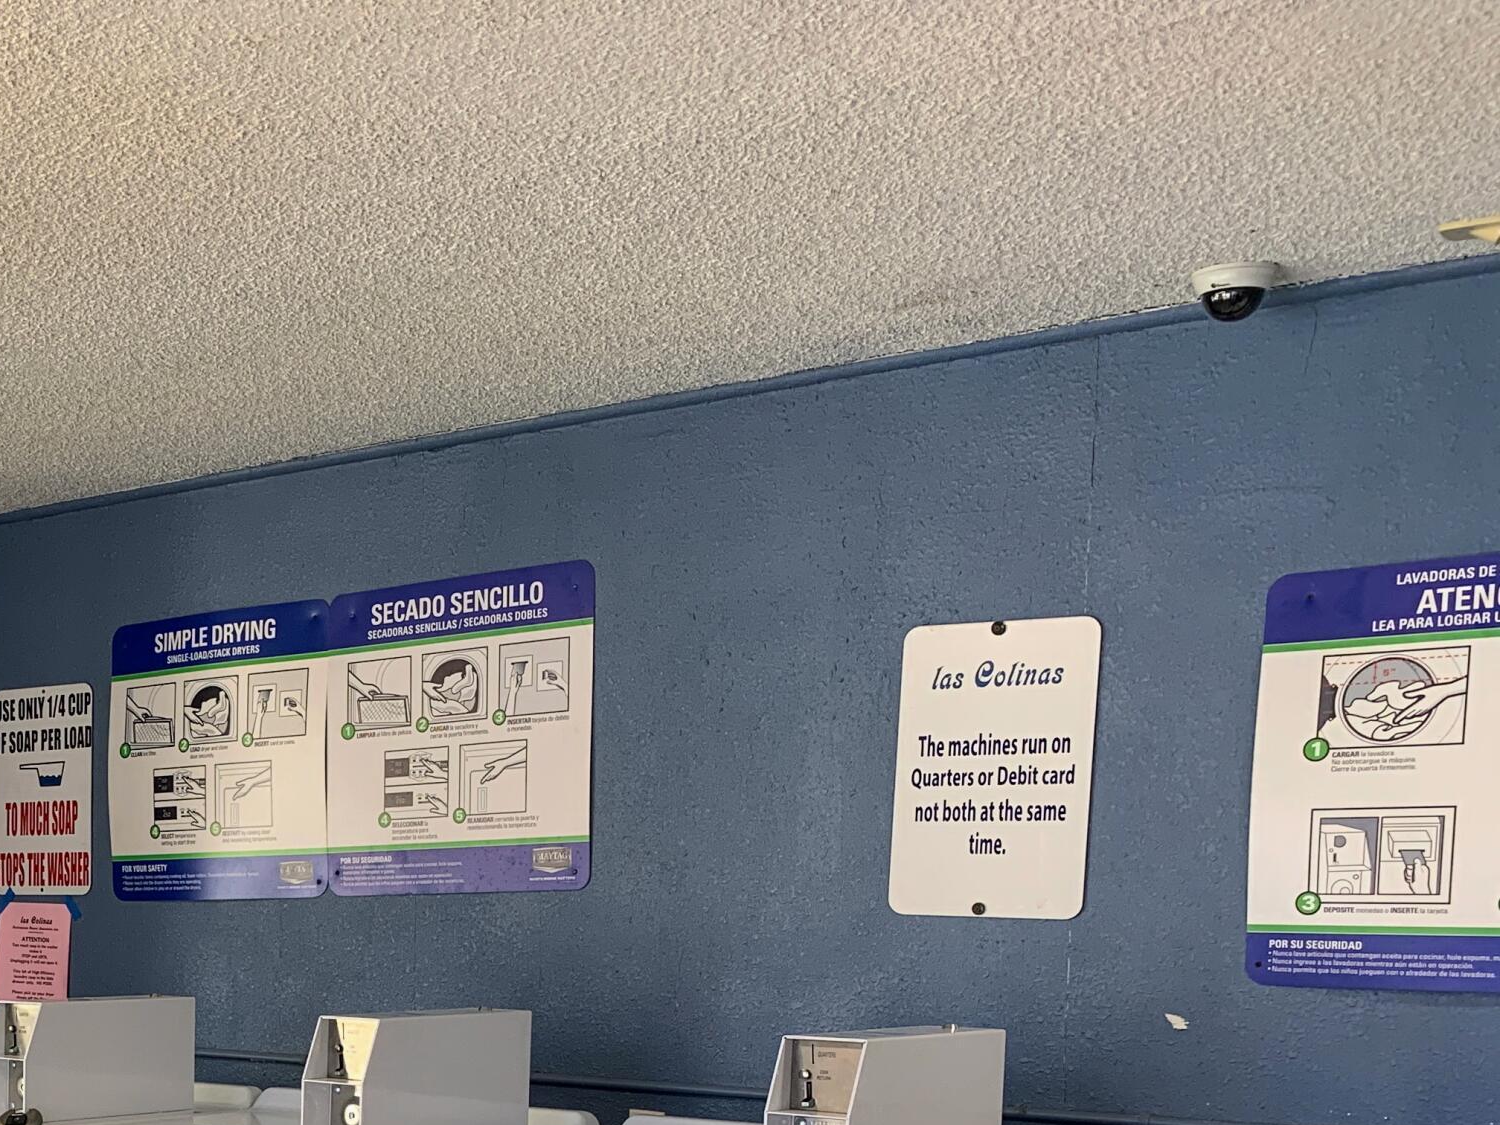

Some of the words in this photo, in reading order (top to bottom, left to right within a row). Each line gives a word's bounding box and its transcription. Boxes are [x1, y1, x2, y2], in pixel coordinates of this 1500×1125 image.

[1396, 566, 1476, 585] LAVADORAS
[1479, 564, 1497, 578] DE
[371, 594, 445, 626] SECADO
[450, 581, 544, 614] SENCILLO
[1416, 583, 1500, 614] ATEN
[368, 622, 414, 640] SECADORAS
[415, 618, 458, 634] SENCILLAS
[464, 612, 513, 628] SECADORAS
[514, 607, 548, 622] DOBLES
[1372, 619, 1396, 632] LEA
[1398, 616, 1434, 630] PARA
[1437, 612, 1491, 628] LOGRAR
[154, 626, 209, 654] SIMPLE
[212, 618, 276, 645] DRYING
[167, 646, 231, 664] SINGLE-LOAD/STACK
[232, 644, 260, 657] DRYERS
[932, 666, 964, 690] las
[974, 660, 1064, 688] Colinas
[18, 696, 46, 720] ONLY
[47, 694, 66, 718] 1/4
[68, 692, 91, 716] CUP
[9, 730, 38, 754] SOAP
[40, 728, 62, 750] PER
[64, 726, 92, 750] LOAD
[919, 734, 945, 757] The
[948, 732, 1018, 757] machines
[1022, 736, 1048, 756] run
[1051, 735, 1071, 754] on
[1312, 742, 1322, 757] 1
[1332, 750, 1360, 758] CARGAR
[912, 768, 974, 789] Quarters
[978, 770, 994, 786] or
[997, 764, 1039, 786] Debit
[1042, 764, 1076, 786] card
[5, 802, 18, 836] TO
[20, 800, 50, 836] MUCH
[52, 800, 78, 836] SOAP
[915, 802, 939, 822] not
[942, 798, 976, 822] both
[980, 802, 995, 822] at
[998, 798, 1023, 822] the
[1026, 804, 1067, 822] same
[969, 832, 1006, 856] time.
[27, 852, 46, 886] THE
[47, 852, 90, 887] WASHER
[133, 864, 148, 872] YOUR
[148, 864, 168, 872] SAFETY
[340, 856, 352, 864] POR
[352, 856, 360, 864] SU
[360, 855, 392, 864] SEGURIDAD
[1302, 896, 1316, 910] 3
[1323, 906, 1354, 914] DEPOSITE
[1268, 939, 1288, 949] POR
[1290, 940, 1304, 950] SU
[1306, 940, 1362, 950] SEGURIDAD
